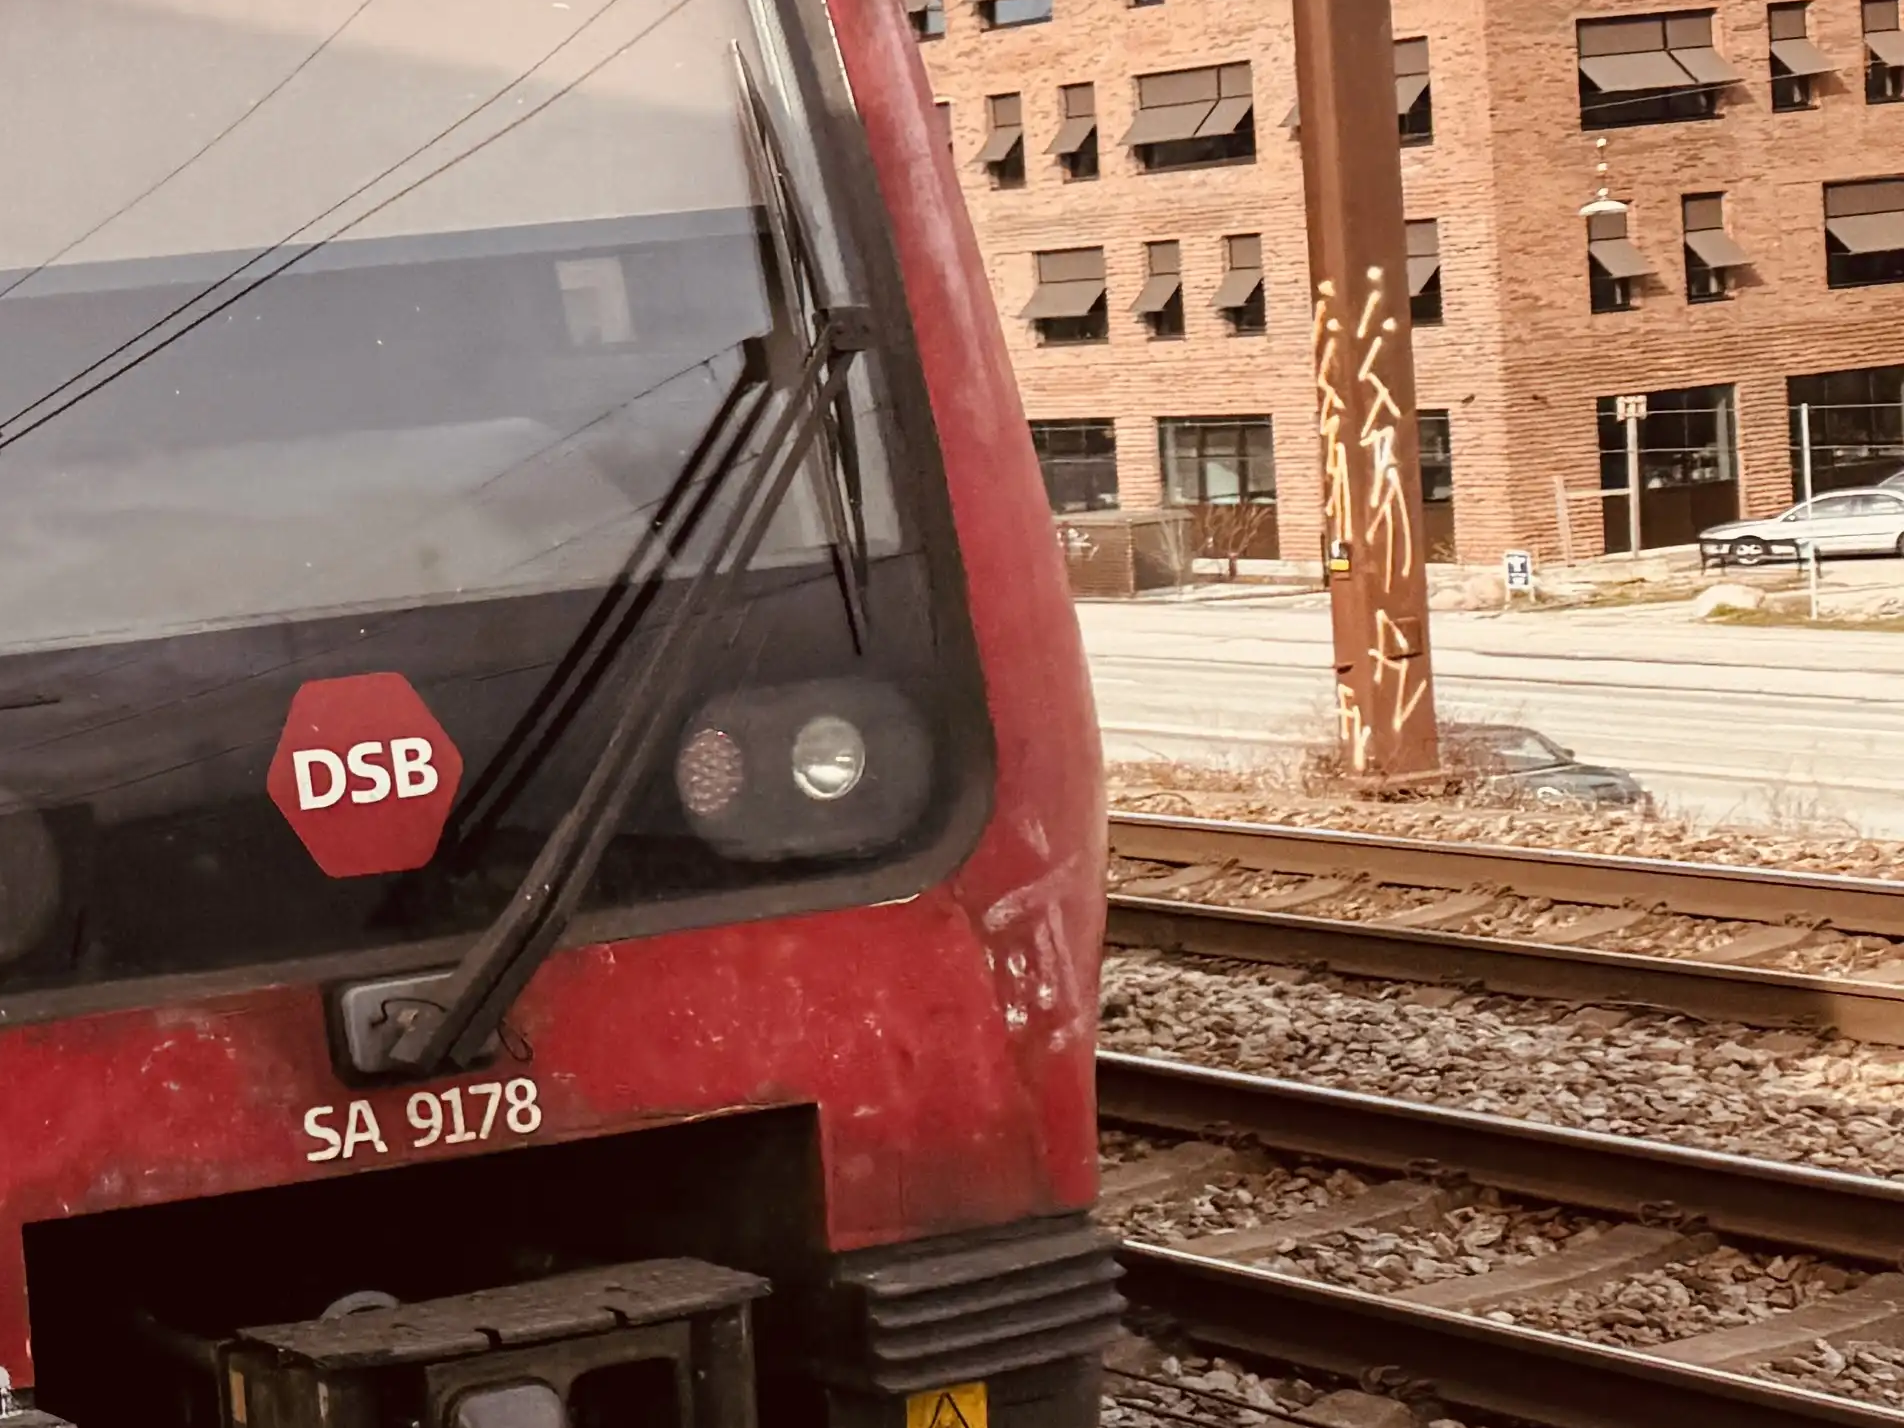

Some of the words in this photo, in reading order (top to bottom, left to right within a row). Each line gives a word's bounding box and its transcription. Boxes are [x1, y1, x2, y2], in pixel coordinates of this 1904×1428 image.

[293, 737, 439, 810] DSB
[304, 1100, 388, 1161] SA
[407, 1078, 542, 1147] 9178
